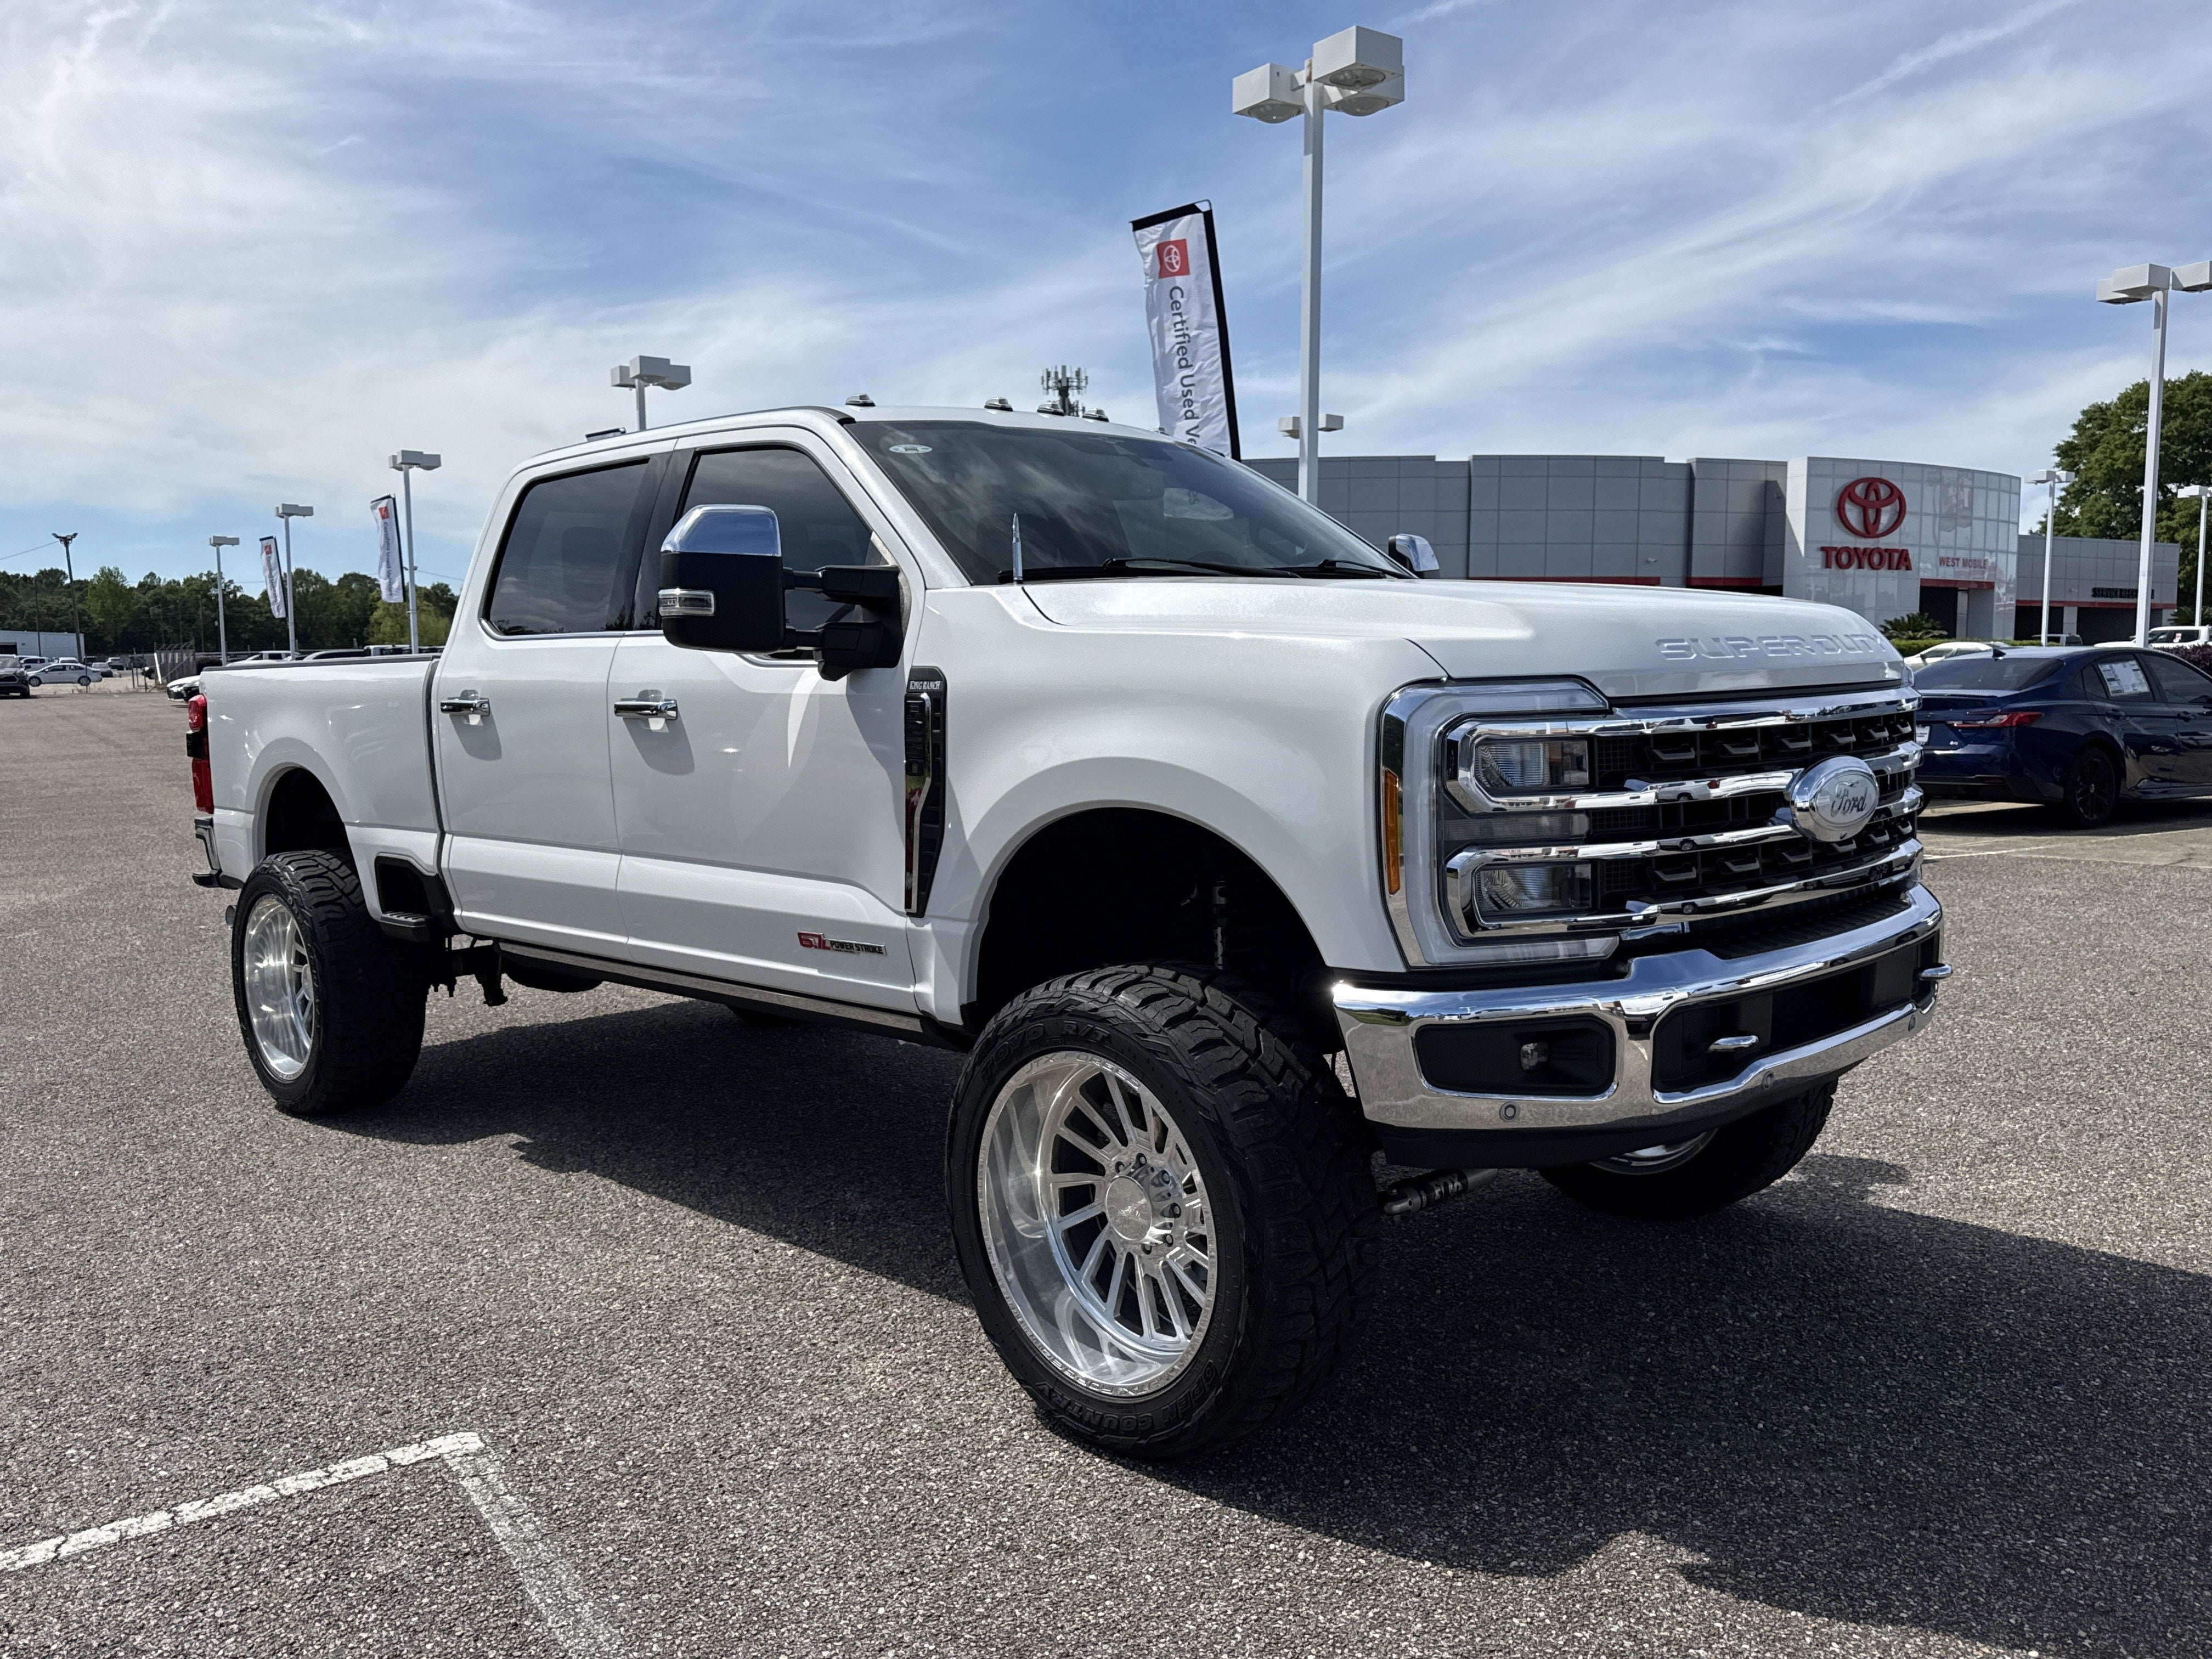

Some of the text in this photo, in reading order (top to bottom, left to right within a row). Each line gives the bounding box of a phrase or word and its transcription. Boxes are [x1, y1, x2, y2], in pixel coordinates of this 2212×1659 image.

[1169, 285, 1193, 369] Certified
[1180, 374, 1199, 420] Used
[1820, 546, 1912, 571] TOYOTA
[1939, 556, 1989, 570] WEST MOBILE
[1655, 633, 1887, 661] SUPER DUTY
[909, 680, 941, 690] KING RANCH
[1830, 780, 1868, 817] Ford
[830, 940, 855, 951] POWER
[854, 943, 884, 955] STROKE
[981, 1019, 1111, 1080] TOYO R/T
[1064, 1052, 1142, 1090] FORGED
[1035, 1359, 1216, 1431] OPEN COUNTRY
